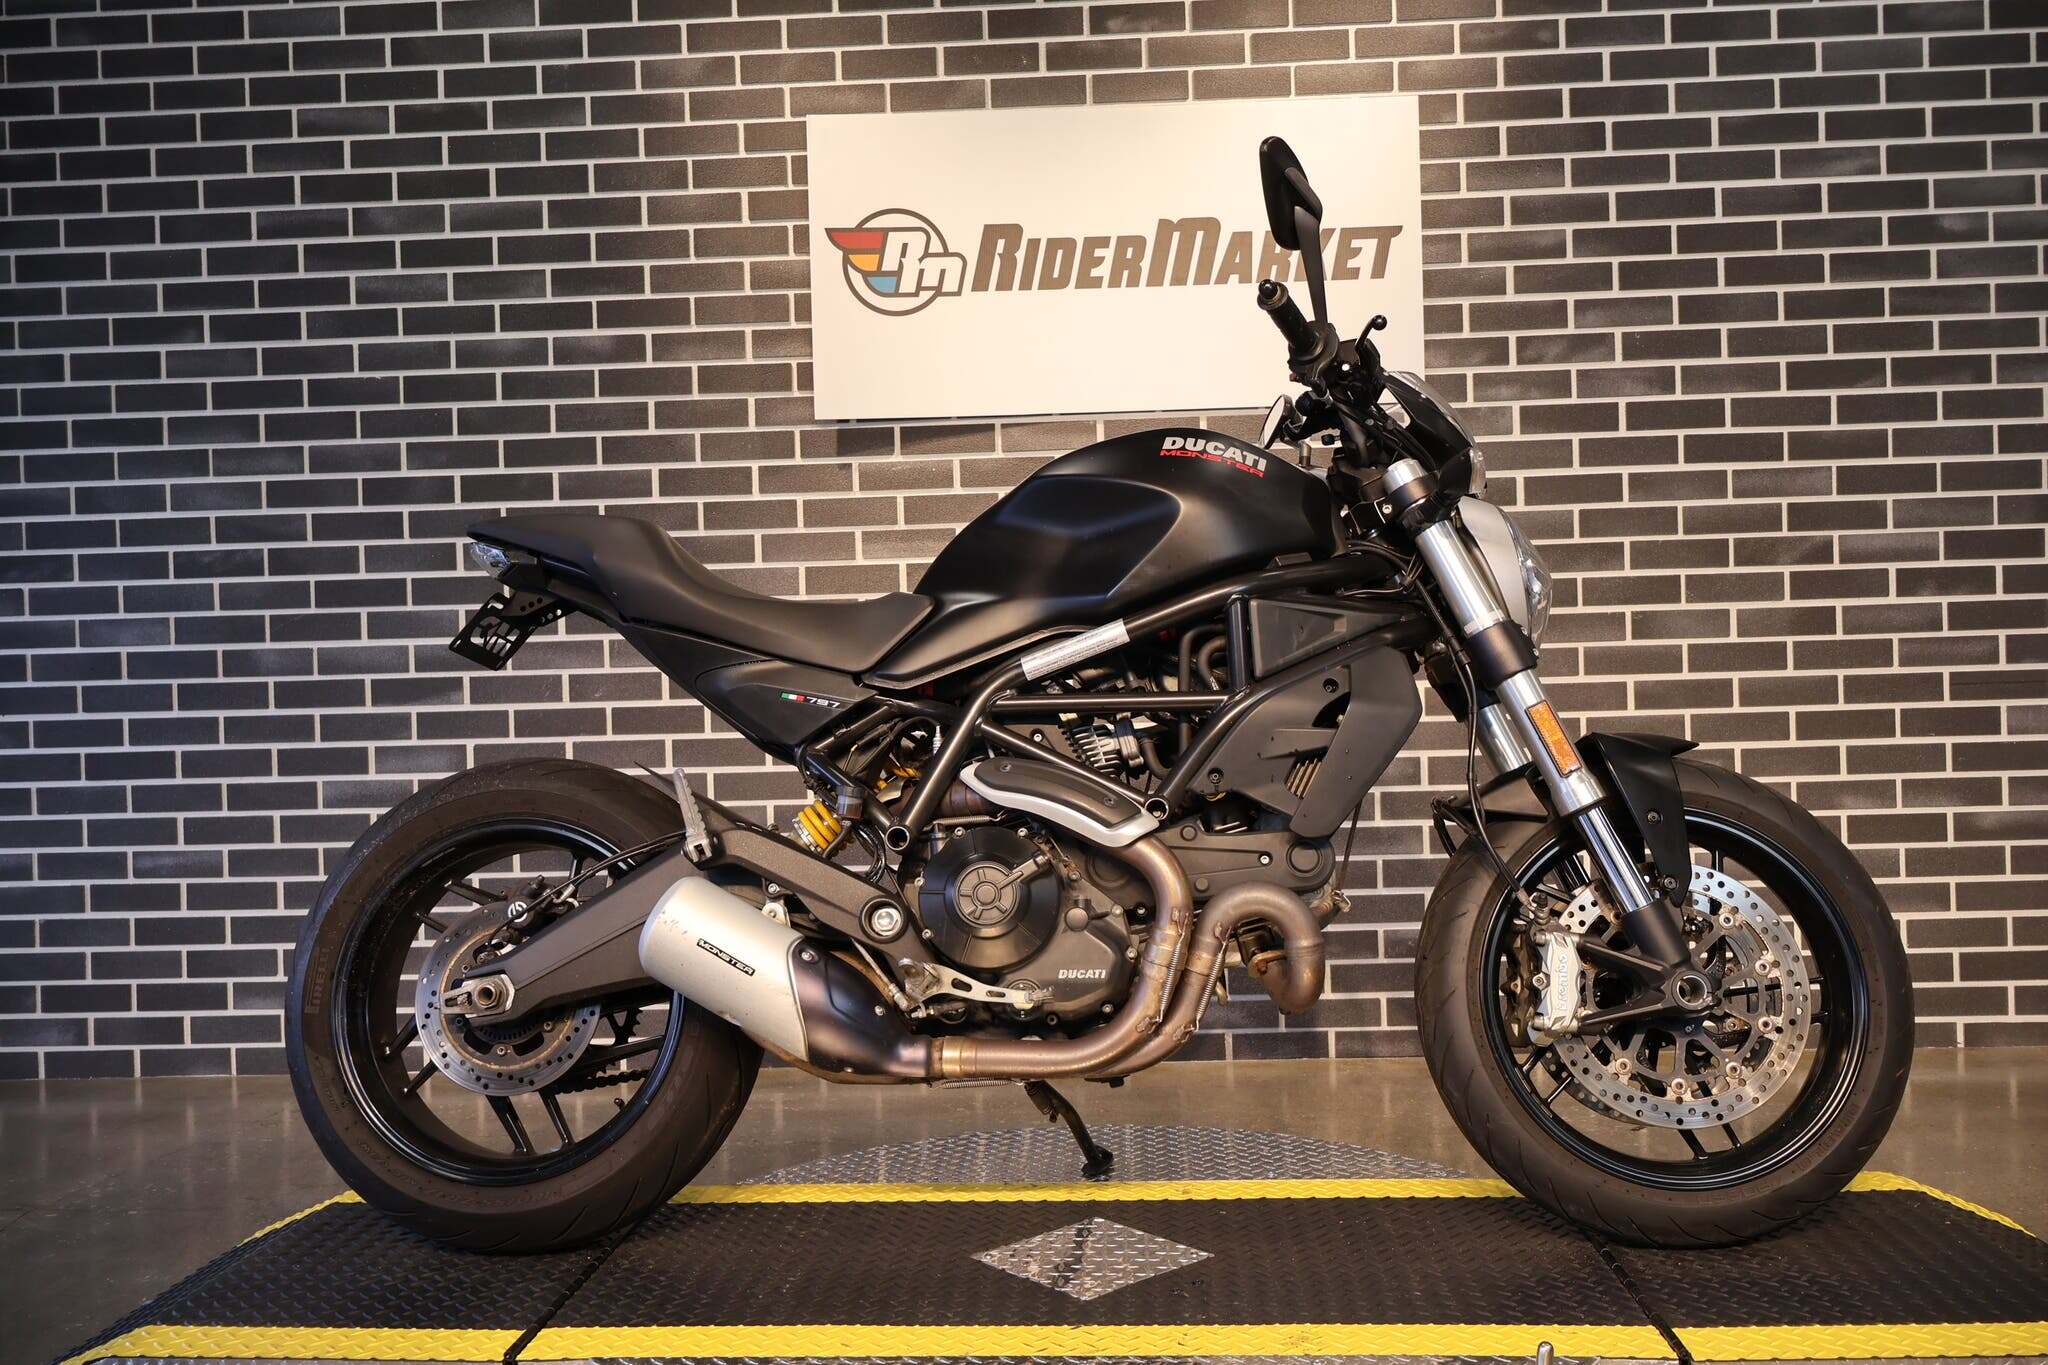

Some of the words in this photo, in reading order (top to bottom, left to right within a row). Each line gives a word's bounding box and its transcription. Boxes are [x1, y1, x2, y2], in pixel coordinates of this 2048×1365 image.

[1160, 450, 1264, 478] MONSTER
[1162, 436, 1267, 471] DUCATI
[806, 696, 840, 708] 797
[698, 939, 754, 975] MONSTER
[1058, 969, 1106, 979] DUCATI
